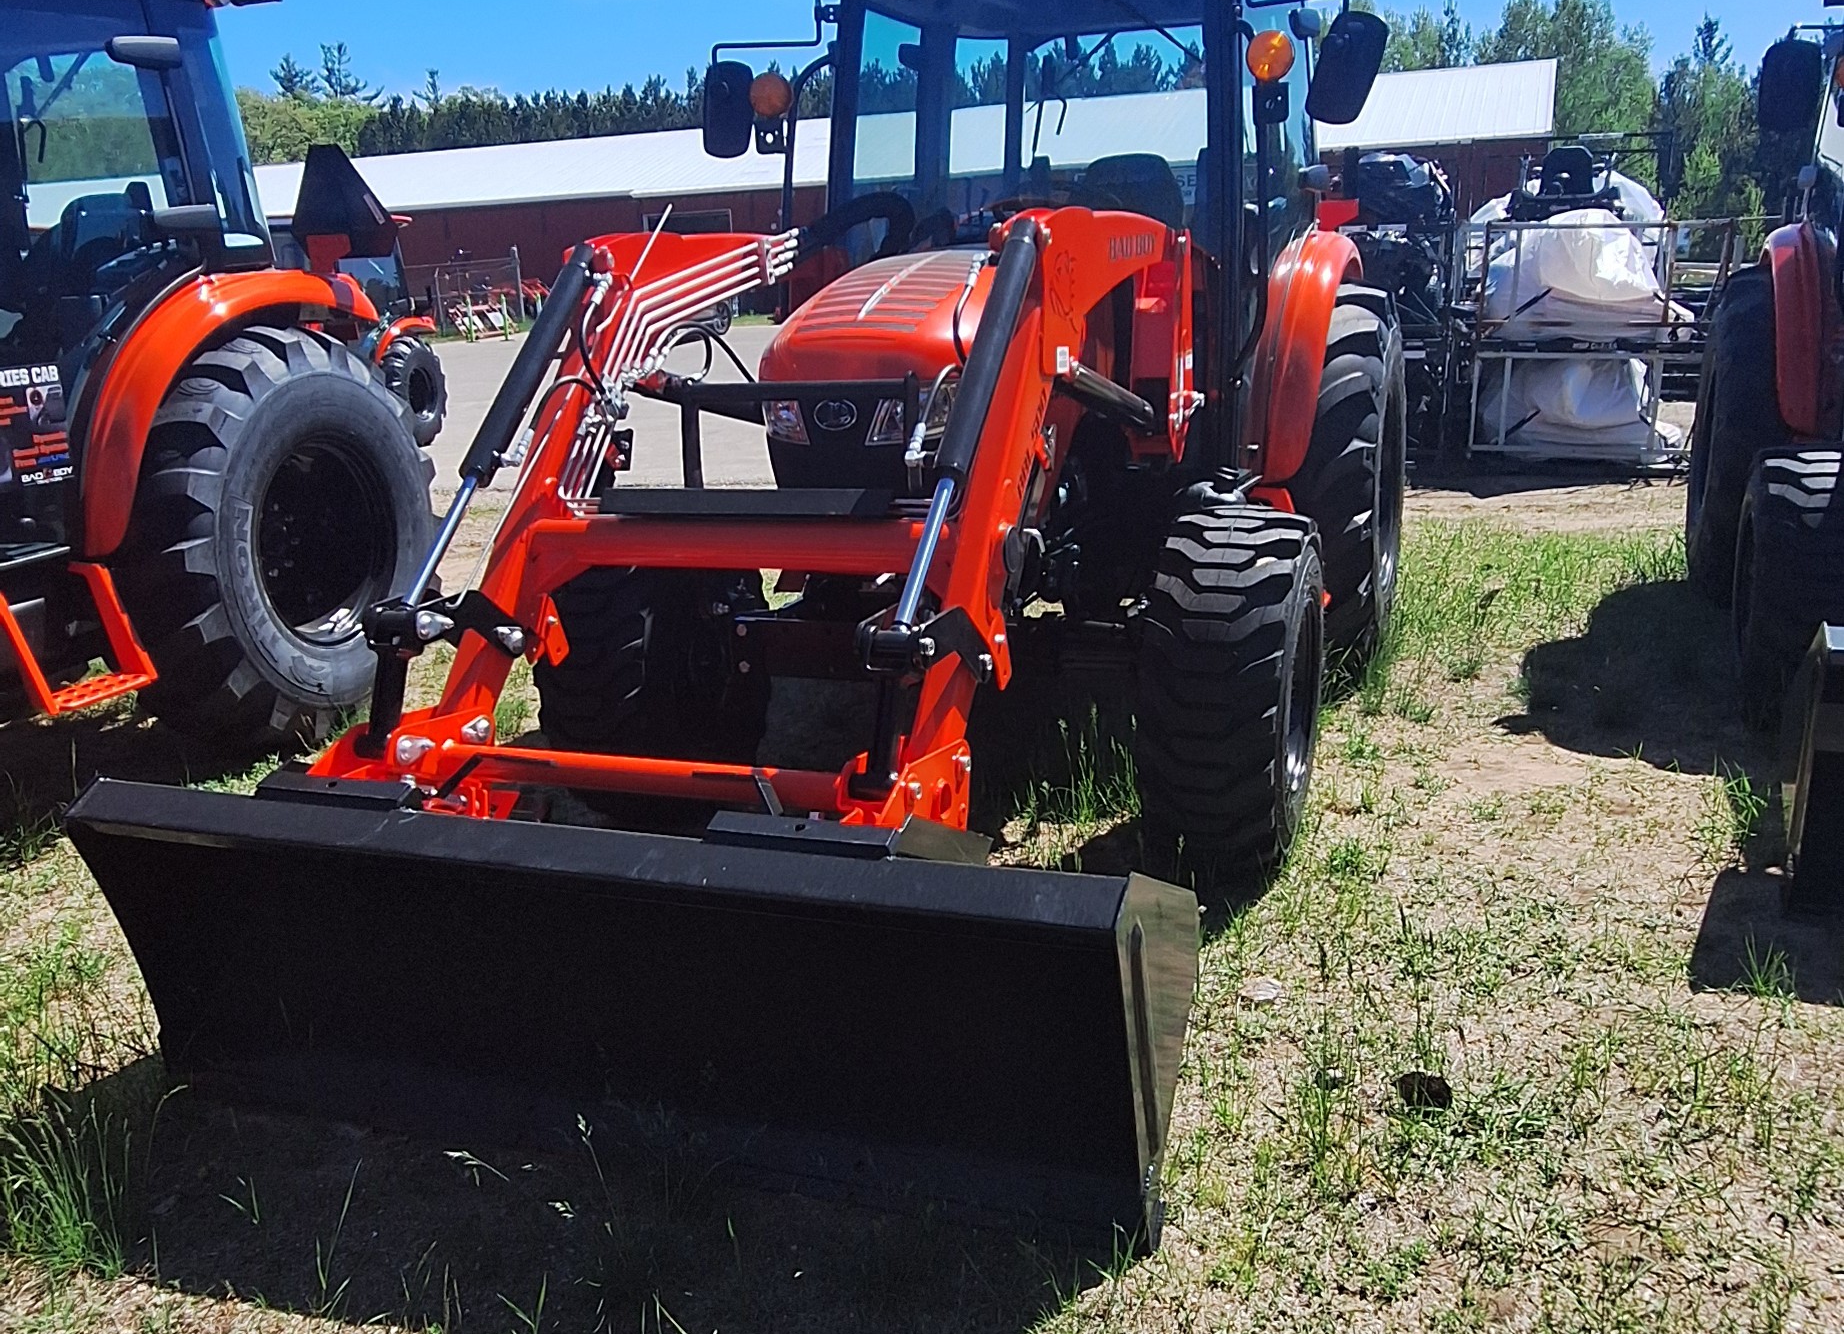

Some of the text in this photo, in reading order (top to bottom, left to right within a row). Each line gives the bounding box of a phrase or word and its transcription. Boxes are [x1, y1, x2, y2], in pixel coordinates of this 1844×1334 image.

[31, 365, 59, 383] CAB
[21, 471, 44, 483] BAD
[53, 466, 74, 478] BOY
